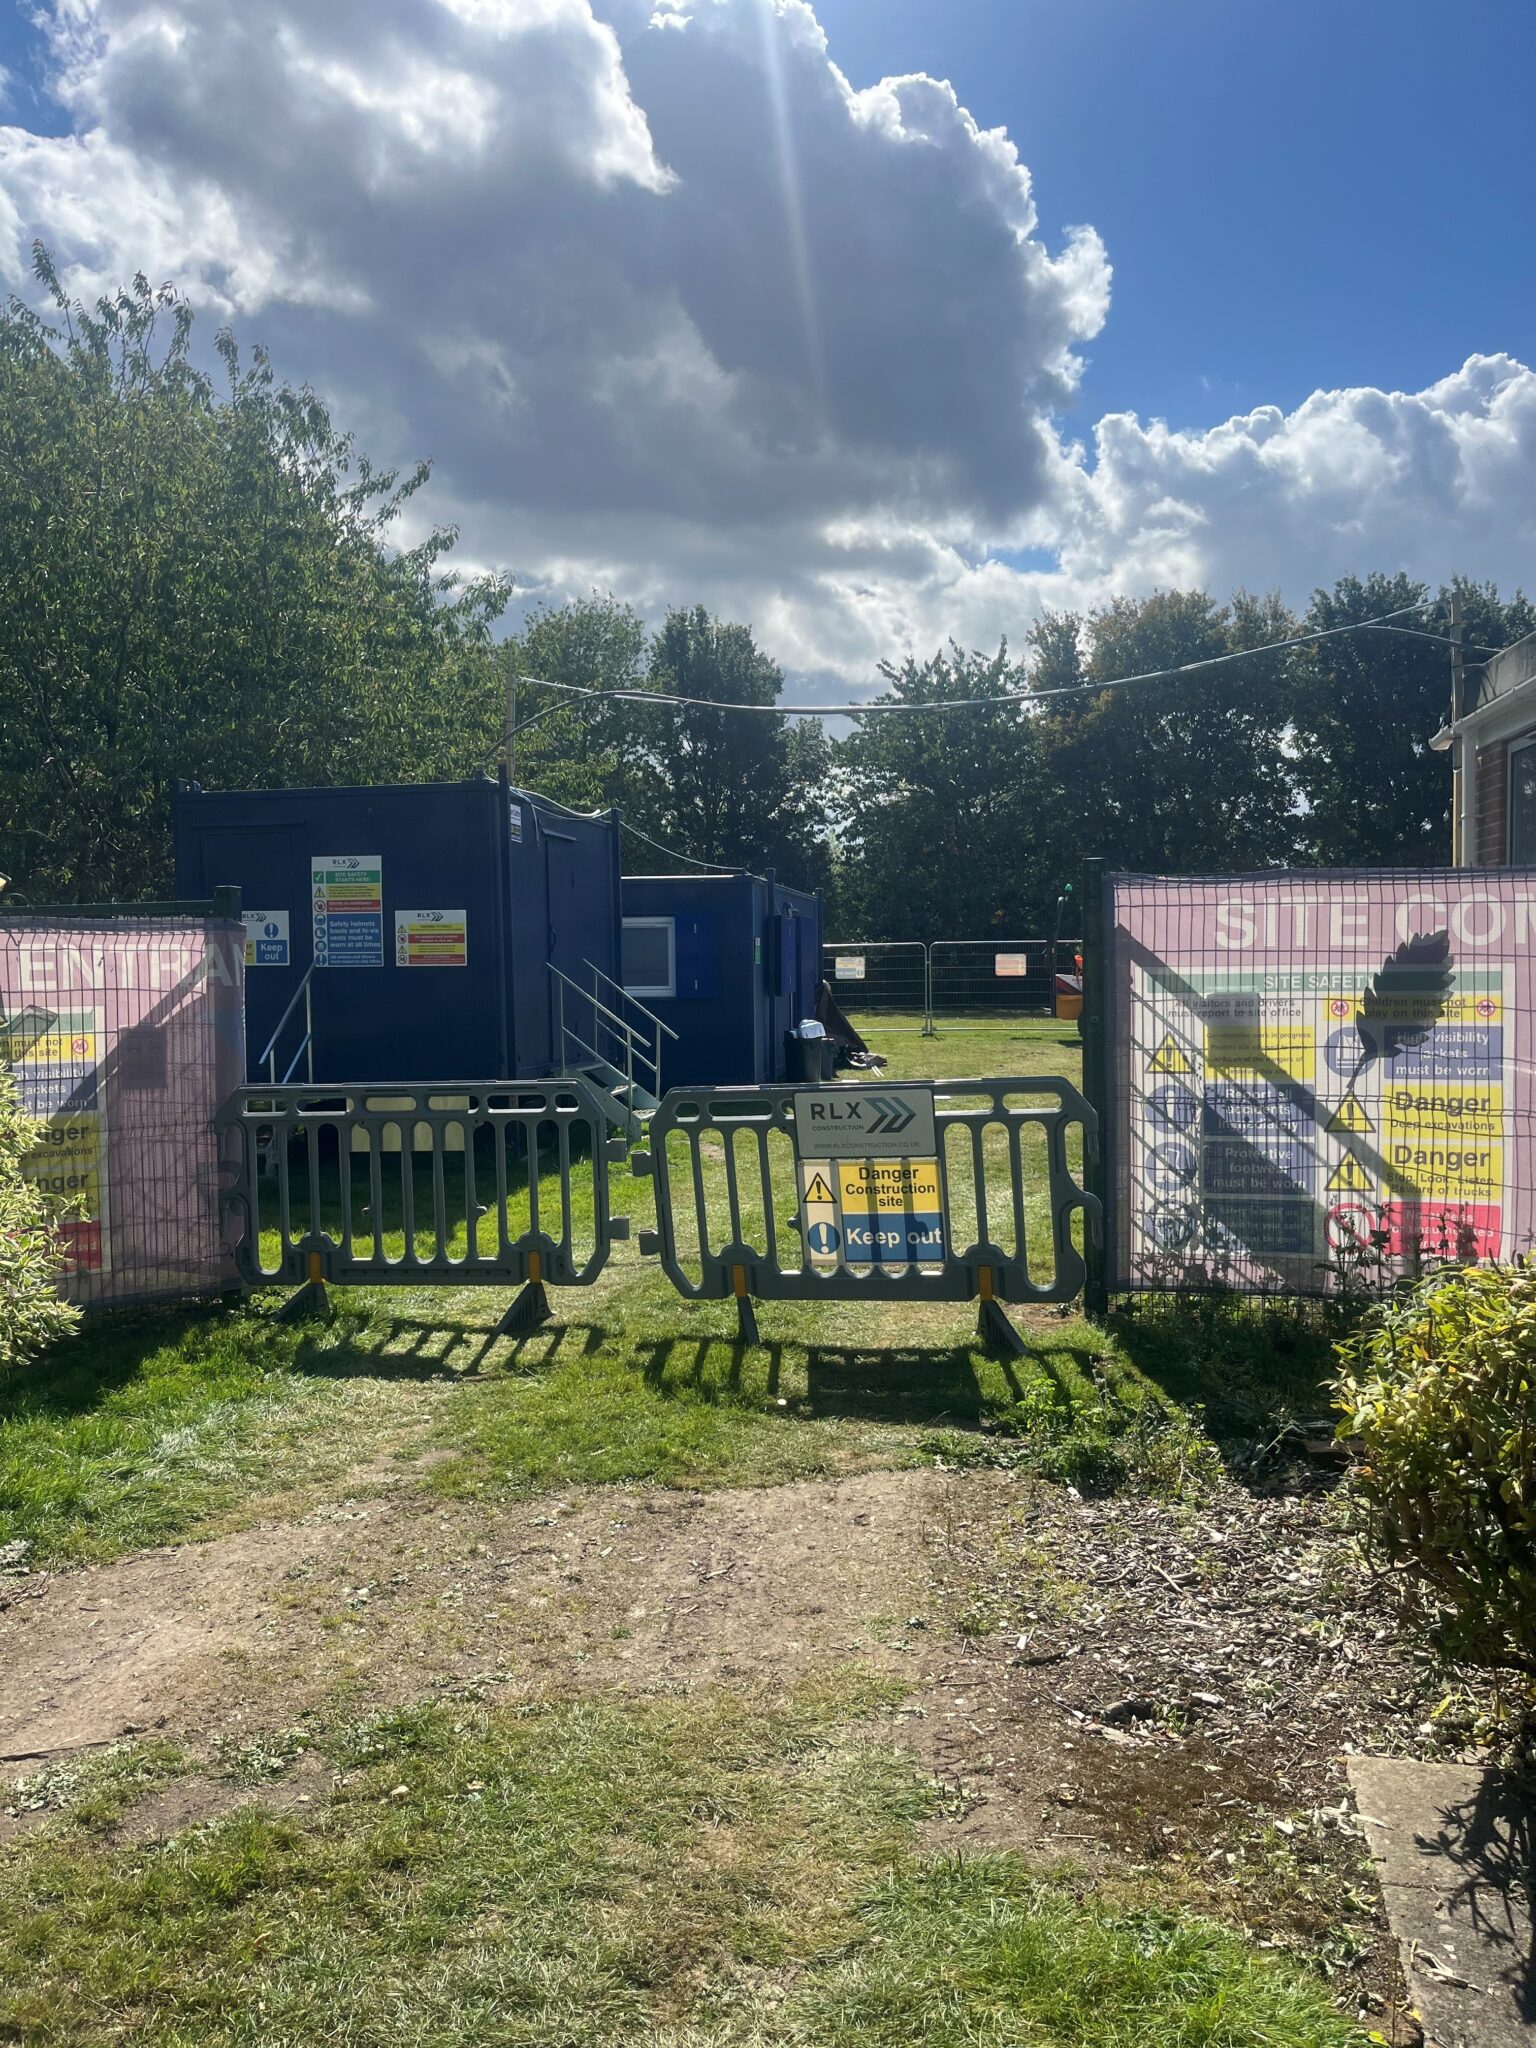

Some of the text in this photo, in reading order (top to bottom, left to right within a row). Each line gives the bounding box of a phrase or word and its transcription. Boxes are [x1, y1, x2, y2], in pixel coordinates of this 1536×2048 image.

[329, 920, 349, 928] Safety
[1213, 896, 1369, 949] SITE
[261, 943, 283, 952] Keep
[1264, 975, 1301, 989] SITE
[1193, 999, 1231, 1007] visitors
[1234, 999, 1255, 1007] and
[1258, 999, 1295, 1007] drivers
[1448, 998, 1466, 1007] not
[1198, 1009, 1230, 1019] report
[1233, 1008, 1245, 1017] to
[1248, 1008, 1267, 1017] site
[1270, 1008, 1301, 1017] office
[1393, 1009, 1408, 1017] on
[1440, 1008, 1460, 1018] site
[45, 1038, 63, 1047] not
[1434, 1031, 1489, 1044] visibility
[38, 1048, 58, 1057] site
[33, 1067, 84, 1080] visibility
[1395, 1064, 1429, 1076] must
[1434, 1064, 1452, 1076] be
[1225, 1088, 1272, 1102] Report
[1395, 1091, 1491, 1117] Danger
[810, 1101, 863, 1120] RLX
[811, 1124, 864, 1132] CONSTRUCTION
[1390, 1120, 1496, 1132] Deep excavations
[1225, 1147, 1294, 1159] Protective
[1394, 1144, 1491, 1172] Danger
[858, 1166, 920, 1183] Danger
[845, 1183, 936, 1195] Construction
[1213, 1178, 1307, 1189] must be worn
[1390, 1183, 1492, 1197] Beware of trucks
[878, 1196, 904, 1207] site
[846, 1227, 943, 1248] Keep out
